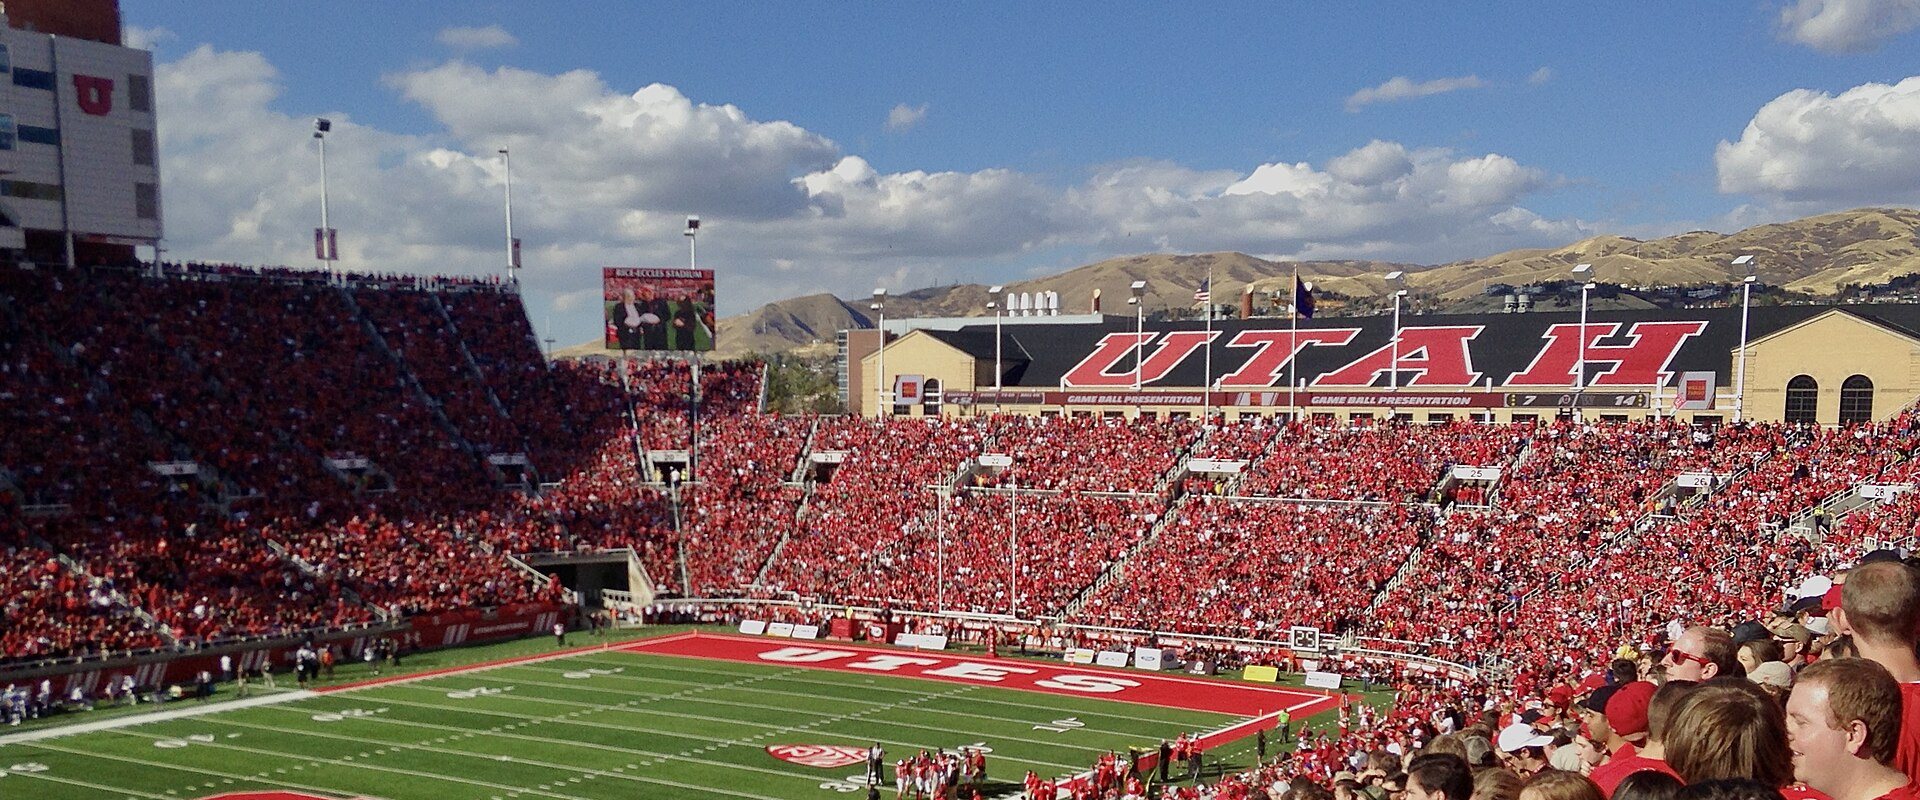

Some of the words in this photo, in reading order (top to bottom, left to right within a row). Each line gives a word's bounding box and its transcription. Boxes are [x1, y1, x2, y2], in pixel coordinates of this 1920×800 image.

[1064, 321, 1709, 387] UTAH
[1067, 395, 1098, 403] GAME
[1098, 395, 1123, 403] BALL
[1123, 395, 1202, 404] PRESENTATION
[1311, 396, 1347, 405] GAME
[1347, 396, 1377, 405] BALL
[1377, 396, 1472, 405] PRESENTATION
[1522, 395, 1538, 405] 7
[1614, 395, 1637, 406] 14
[1470, 469, 1483, 478] 25
[1694, 477, 1708, 486] 26
[1874, 487, 1885, 497] 28
[1295, 630, 1316, 648] 25
[757, 647, 1142, 693] UTES
